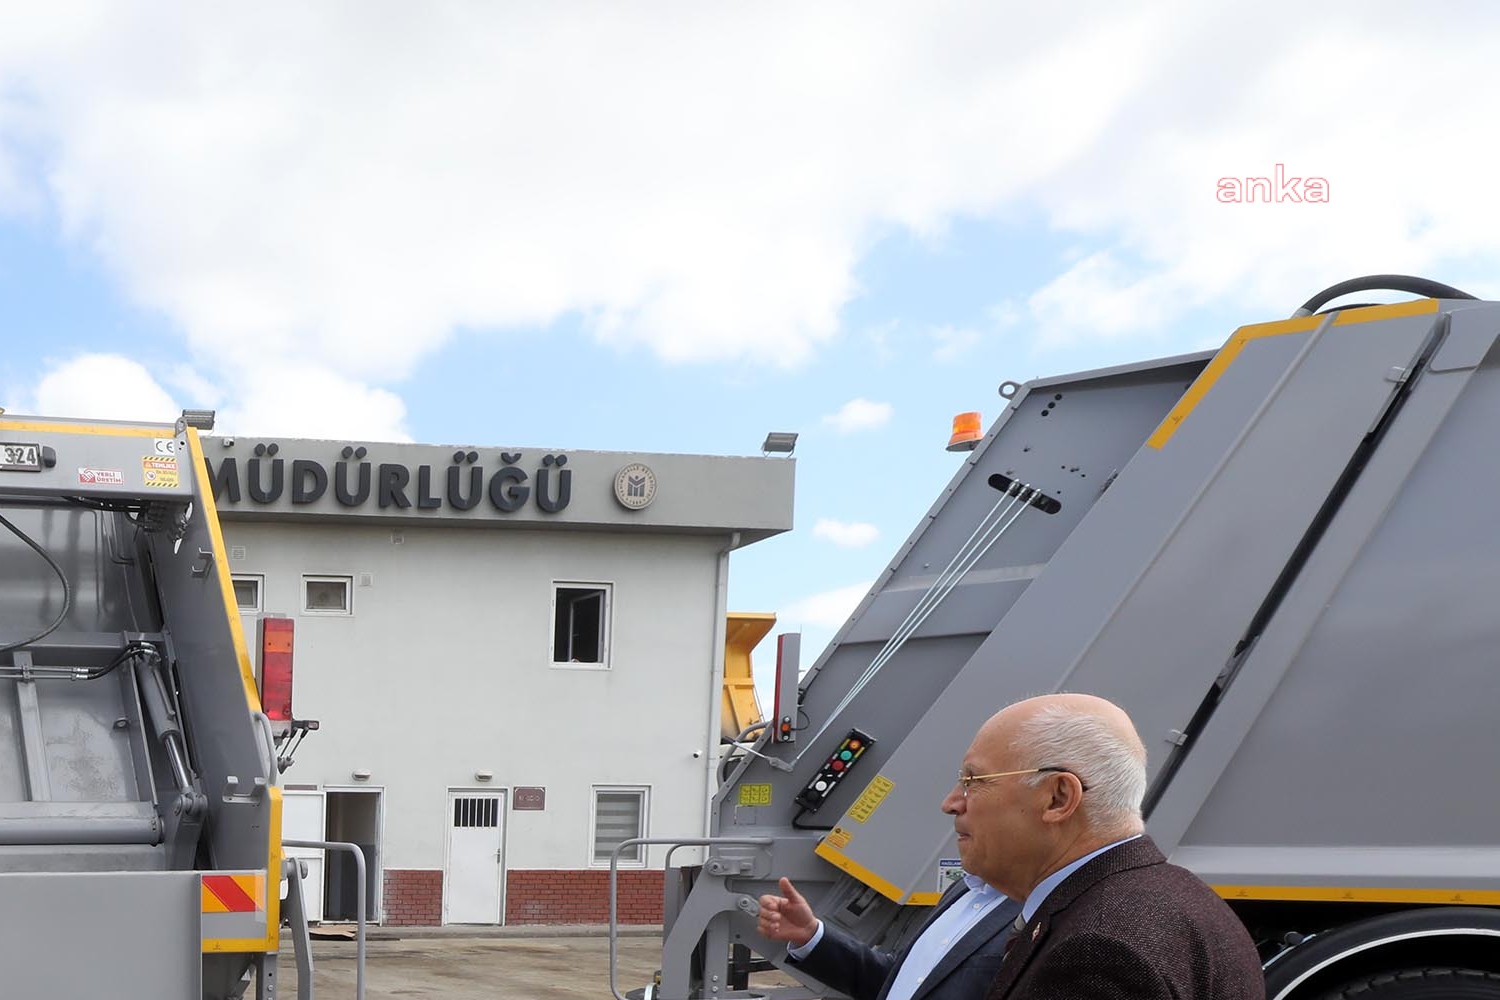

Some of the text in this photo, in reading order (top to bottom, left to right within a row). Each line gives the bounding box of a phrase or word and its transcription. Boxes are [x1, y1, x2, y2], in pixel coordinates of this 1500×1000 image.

[4, 447, 36, 465] 324
[155, 440, 175, 454] CE
[205, 442, 572, 514] MÜDÜRLÜĞÜ
